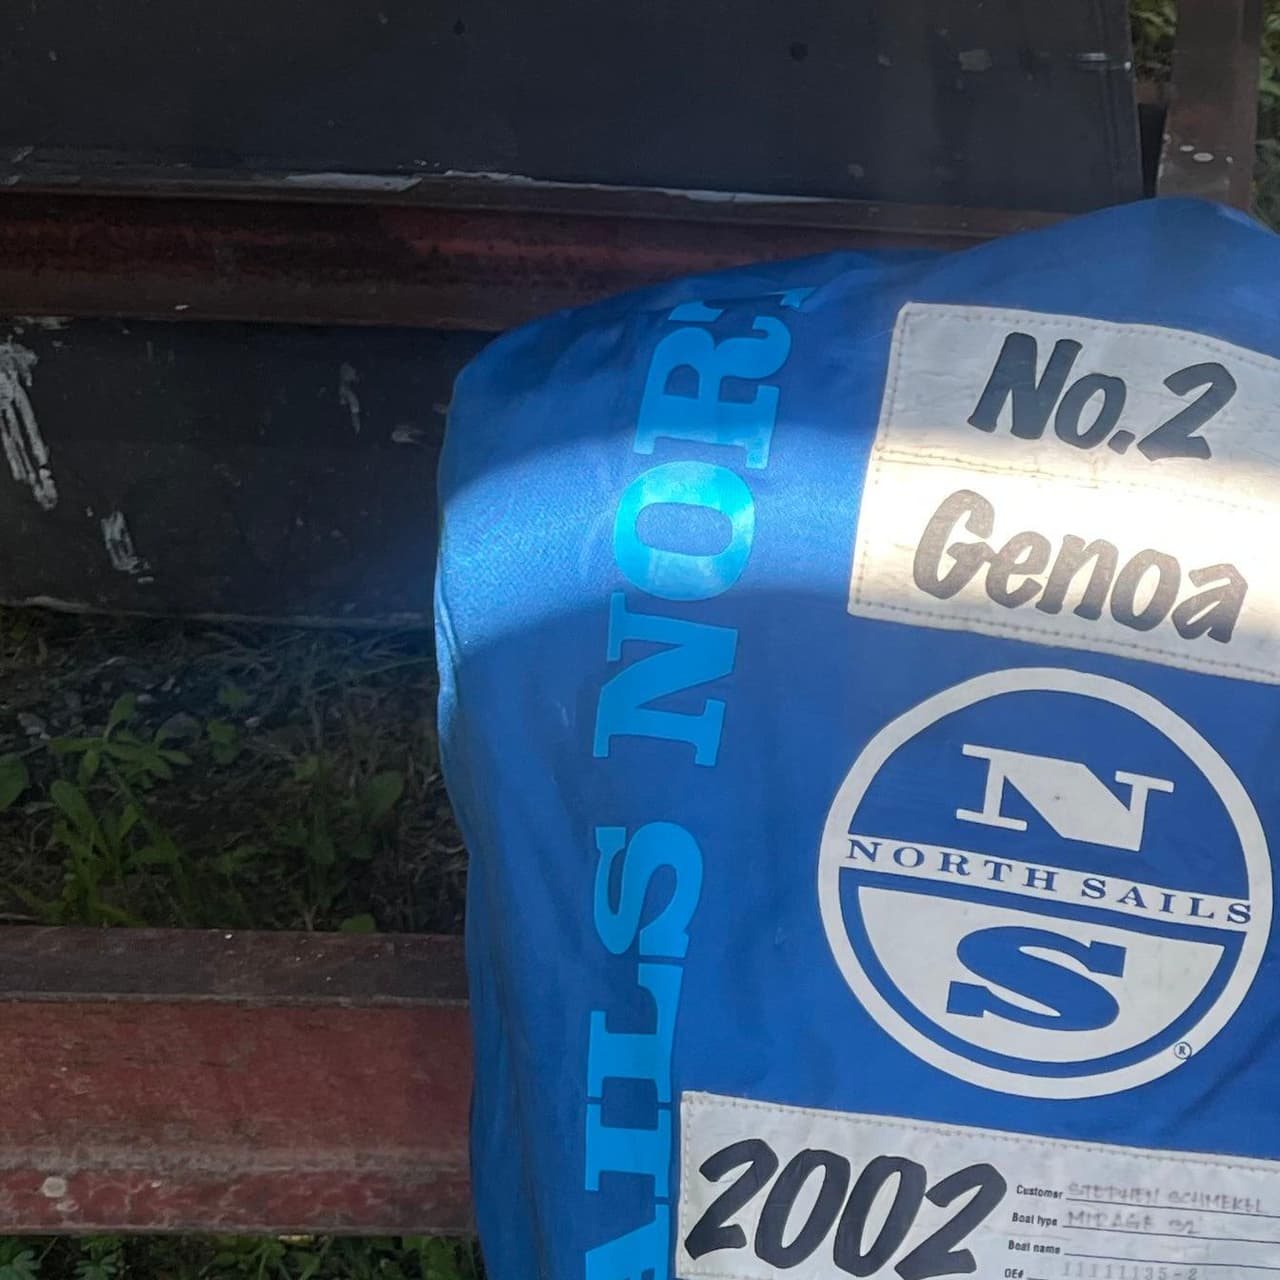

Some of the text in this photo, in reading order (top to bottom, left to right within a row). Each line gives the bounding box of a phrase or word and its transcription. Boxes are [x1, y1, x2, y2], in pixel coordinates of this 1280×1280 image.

[967, 332, 1237, 461] No.2
[593, 287, 815, 767] NOR
[912, 489, 1249, 644] Genoa
[955, 744, 1174, 851] N
[847, 838, 1252, 924] NORTH SAILS
[946, 926, 1127, 1032] S
[1012, 1212, 1034, 1224] Boat
[1037, 1214, 1058, 1227] type
[1016, 1184, 1063, 1200] Customer
[1004, 1268, 1024, 1280] OE#
[1008, 1239, 1061, 1255] Boat name
